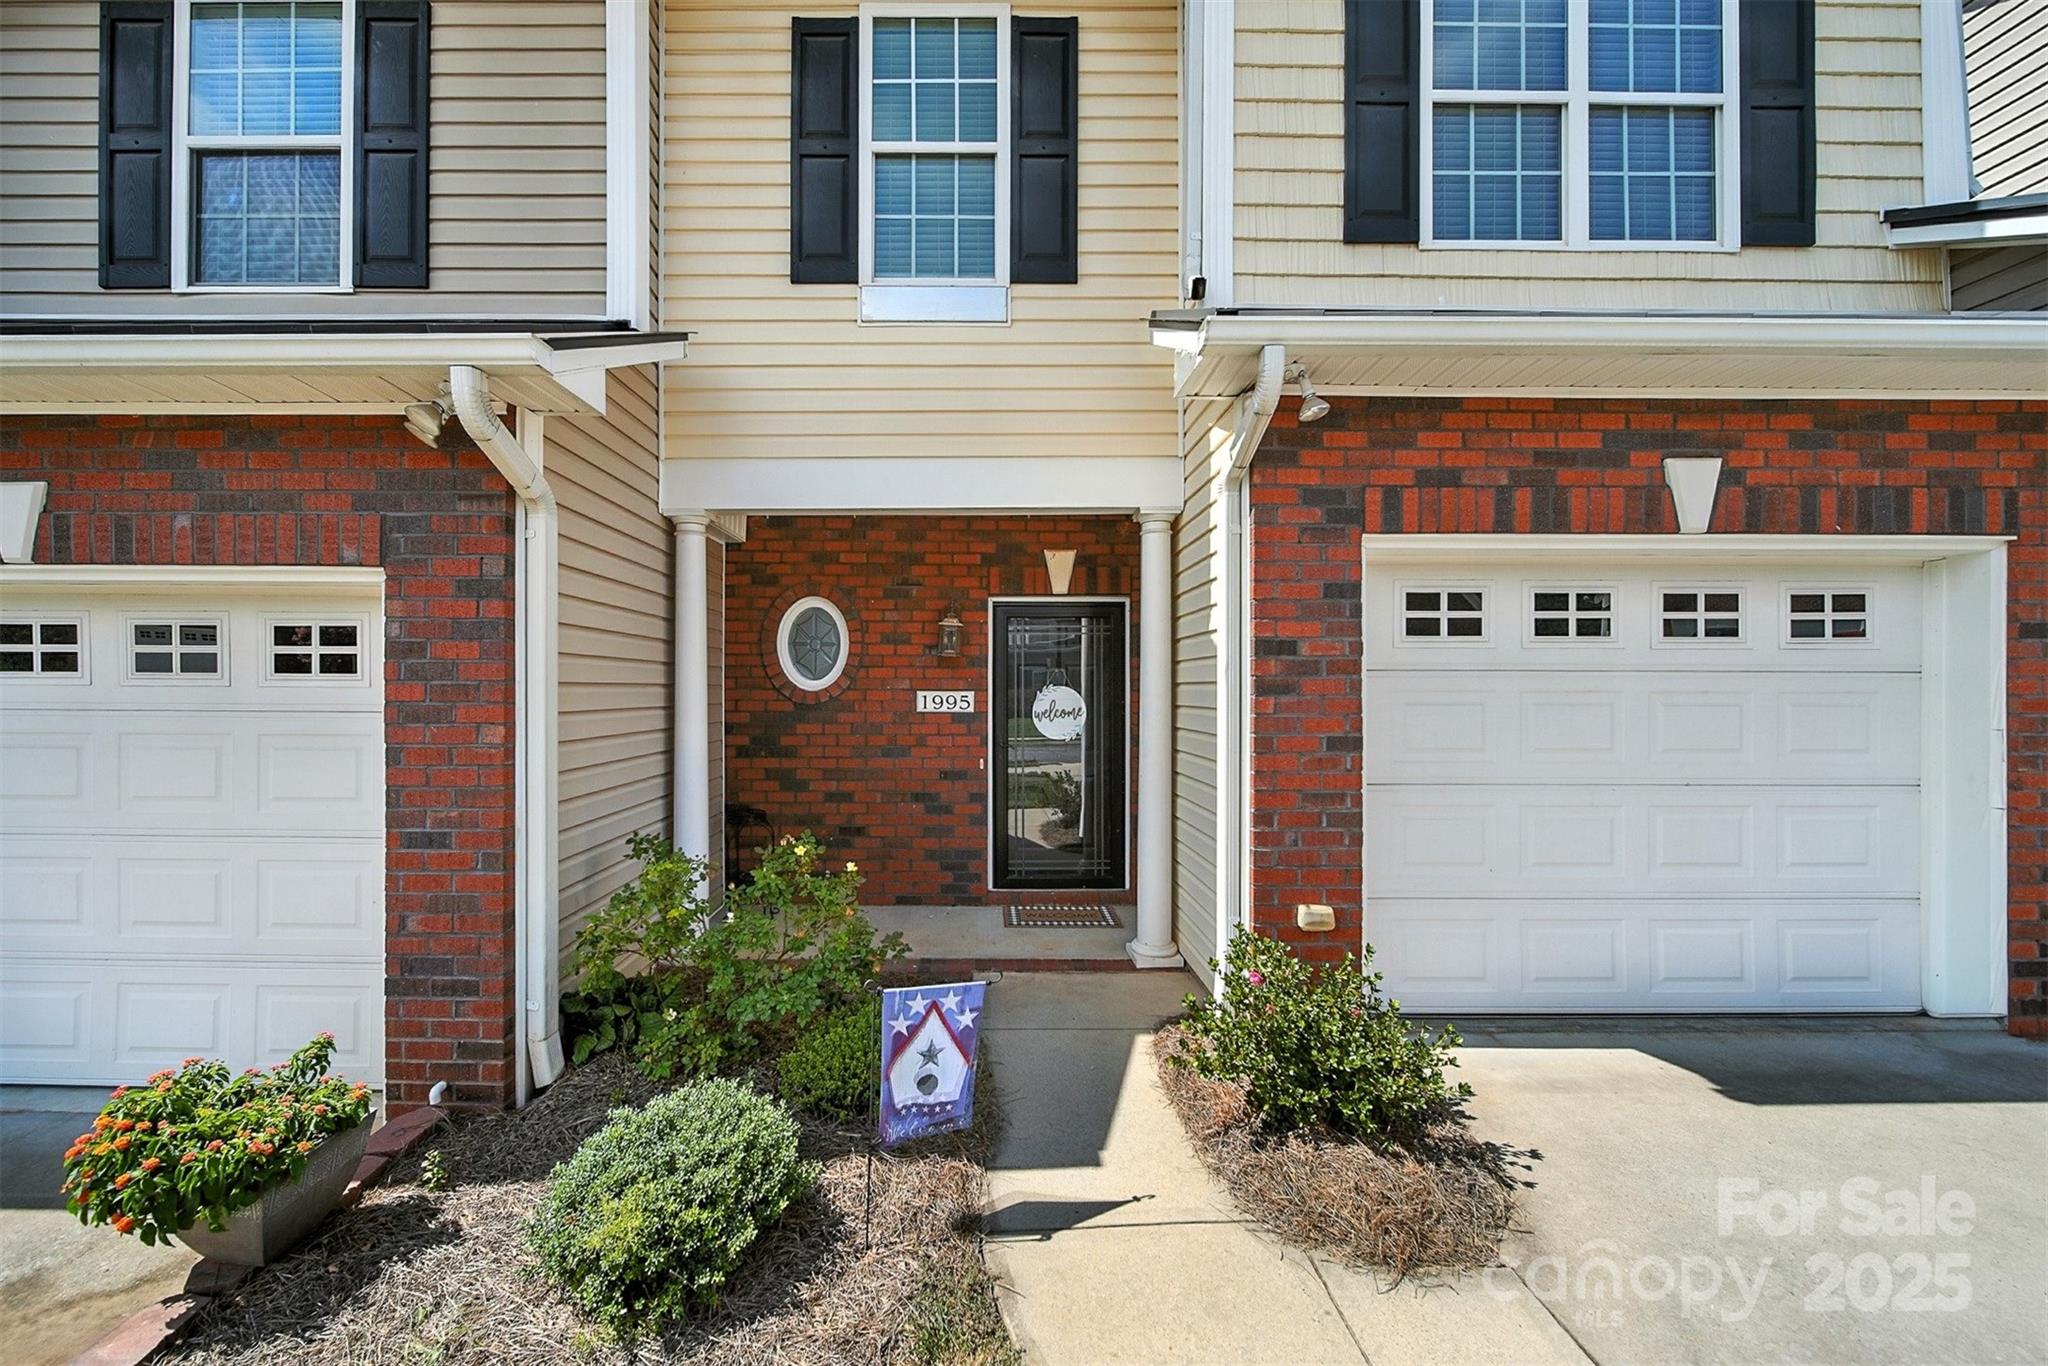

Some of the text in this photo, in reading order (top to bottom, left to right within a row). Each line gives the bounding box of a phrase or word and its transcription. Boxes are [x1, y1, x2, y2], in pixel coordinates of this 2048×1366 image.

[921, 695, 971, 710] 1995
[1034, 700, 1085, 722] welcome
[1024, 911, 1098, 919] WELCOME
